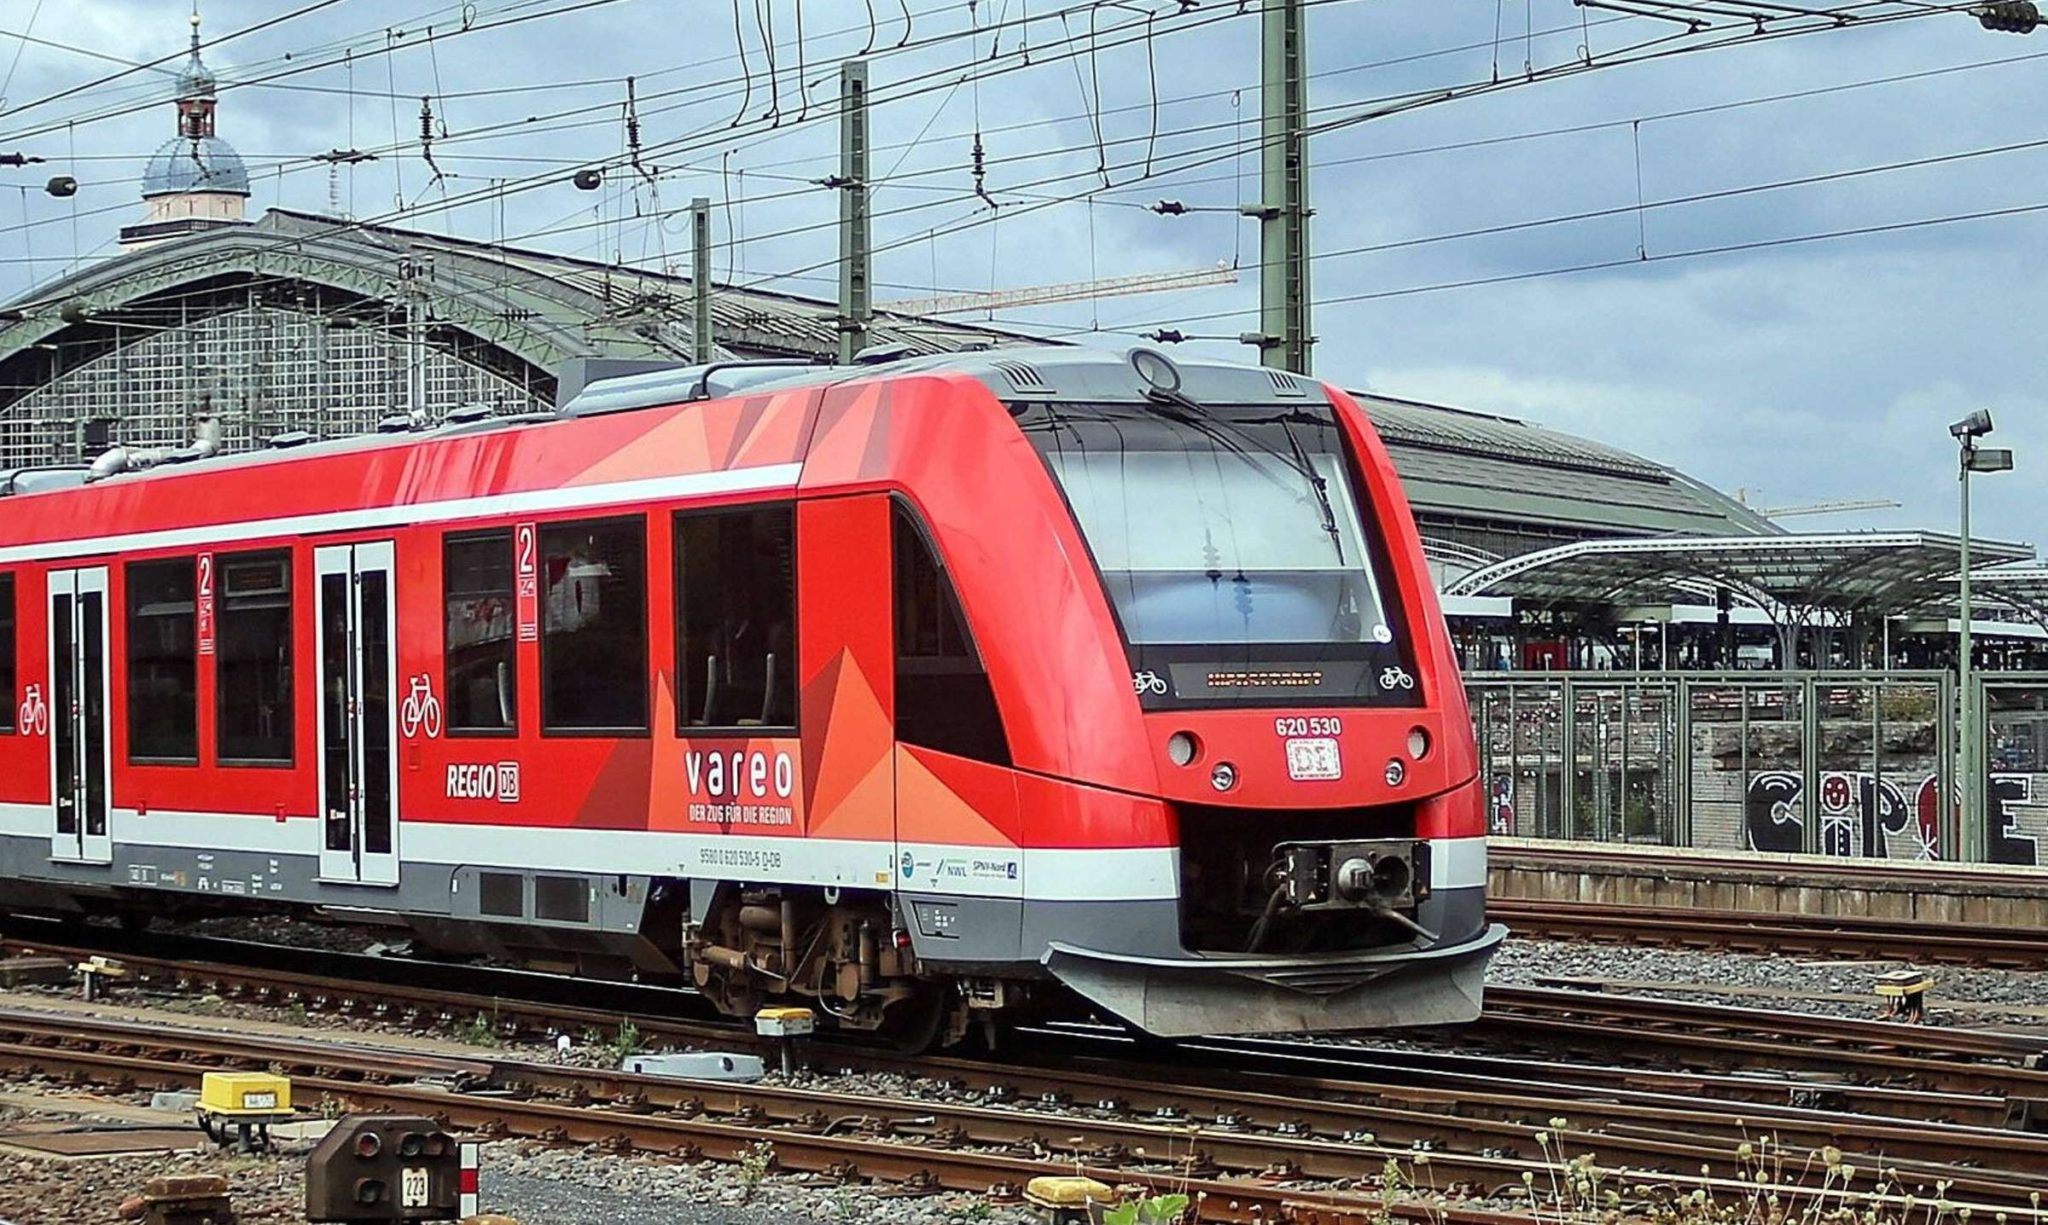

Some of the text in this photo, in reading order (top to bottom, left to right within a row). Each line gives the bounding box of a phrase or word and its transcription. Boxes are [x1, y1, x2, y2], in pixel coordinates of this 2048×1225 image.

[519, 526, 534, 570] 2
[200, 557, 211, 596] 2
[1276, 717, 1341, 736] 620 530
[446, 764, 517, 798] REGIO DB
[685, 751, 793, 798] vareo
[689, 801, 793, 825] DER ZUG FÜR DIE REGION
[406, 1177, 425, 1196] 223
